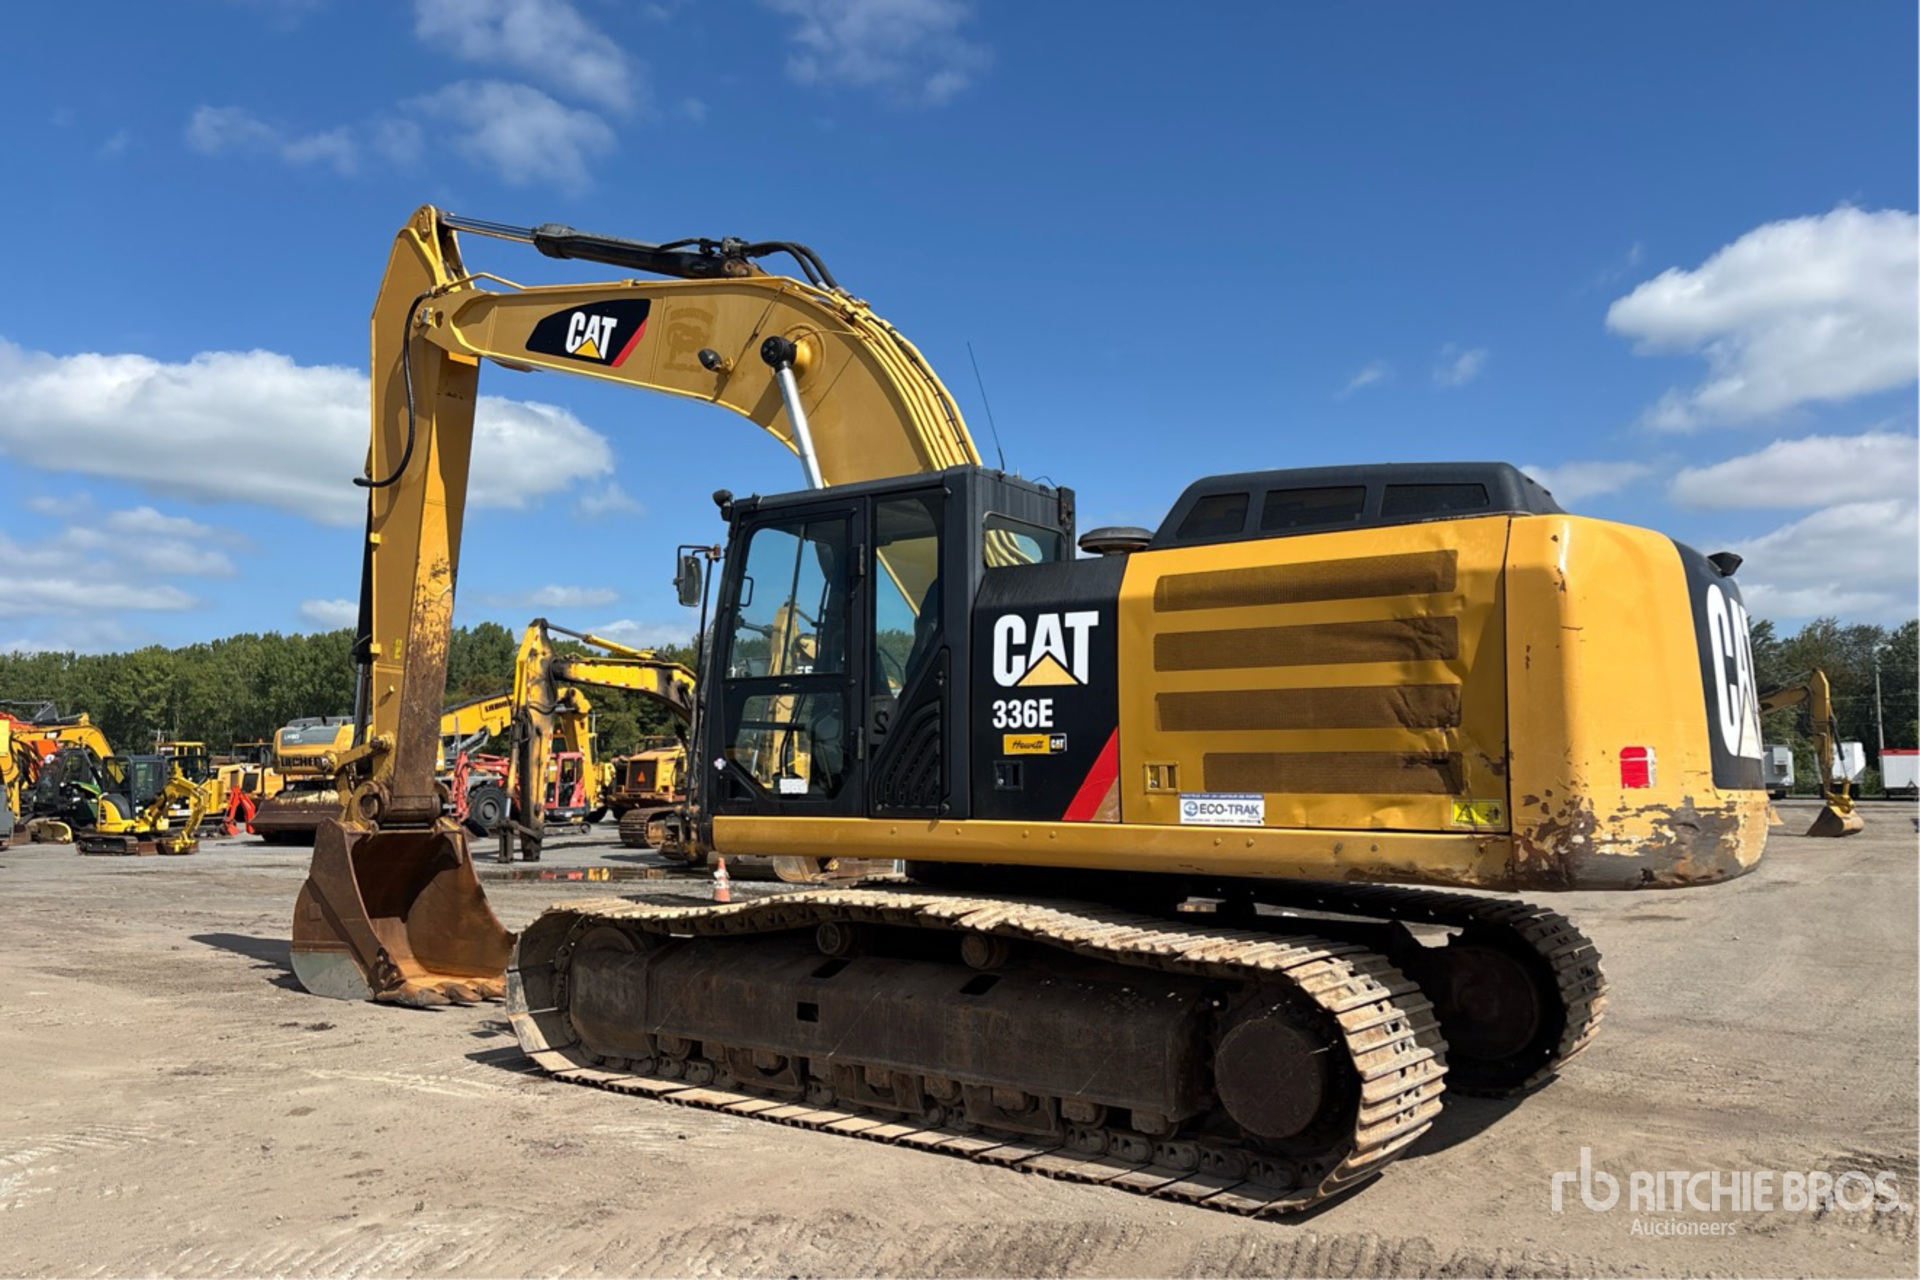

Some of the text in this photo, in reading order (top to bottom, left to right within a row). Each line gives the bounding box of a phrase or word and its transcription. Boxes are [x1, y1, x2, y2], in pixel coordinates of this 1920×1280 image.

[565, 311, 618, 360] CAT
[993, 610, 1099, 687] CAT
[992, 698, 1053, 728] 336E
[1012, 738, 1065, 750] Hewitt CAT
[1199, 803, 1259, 815] ECO-TRAK
